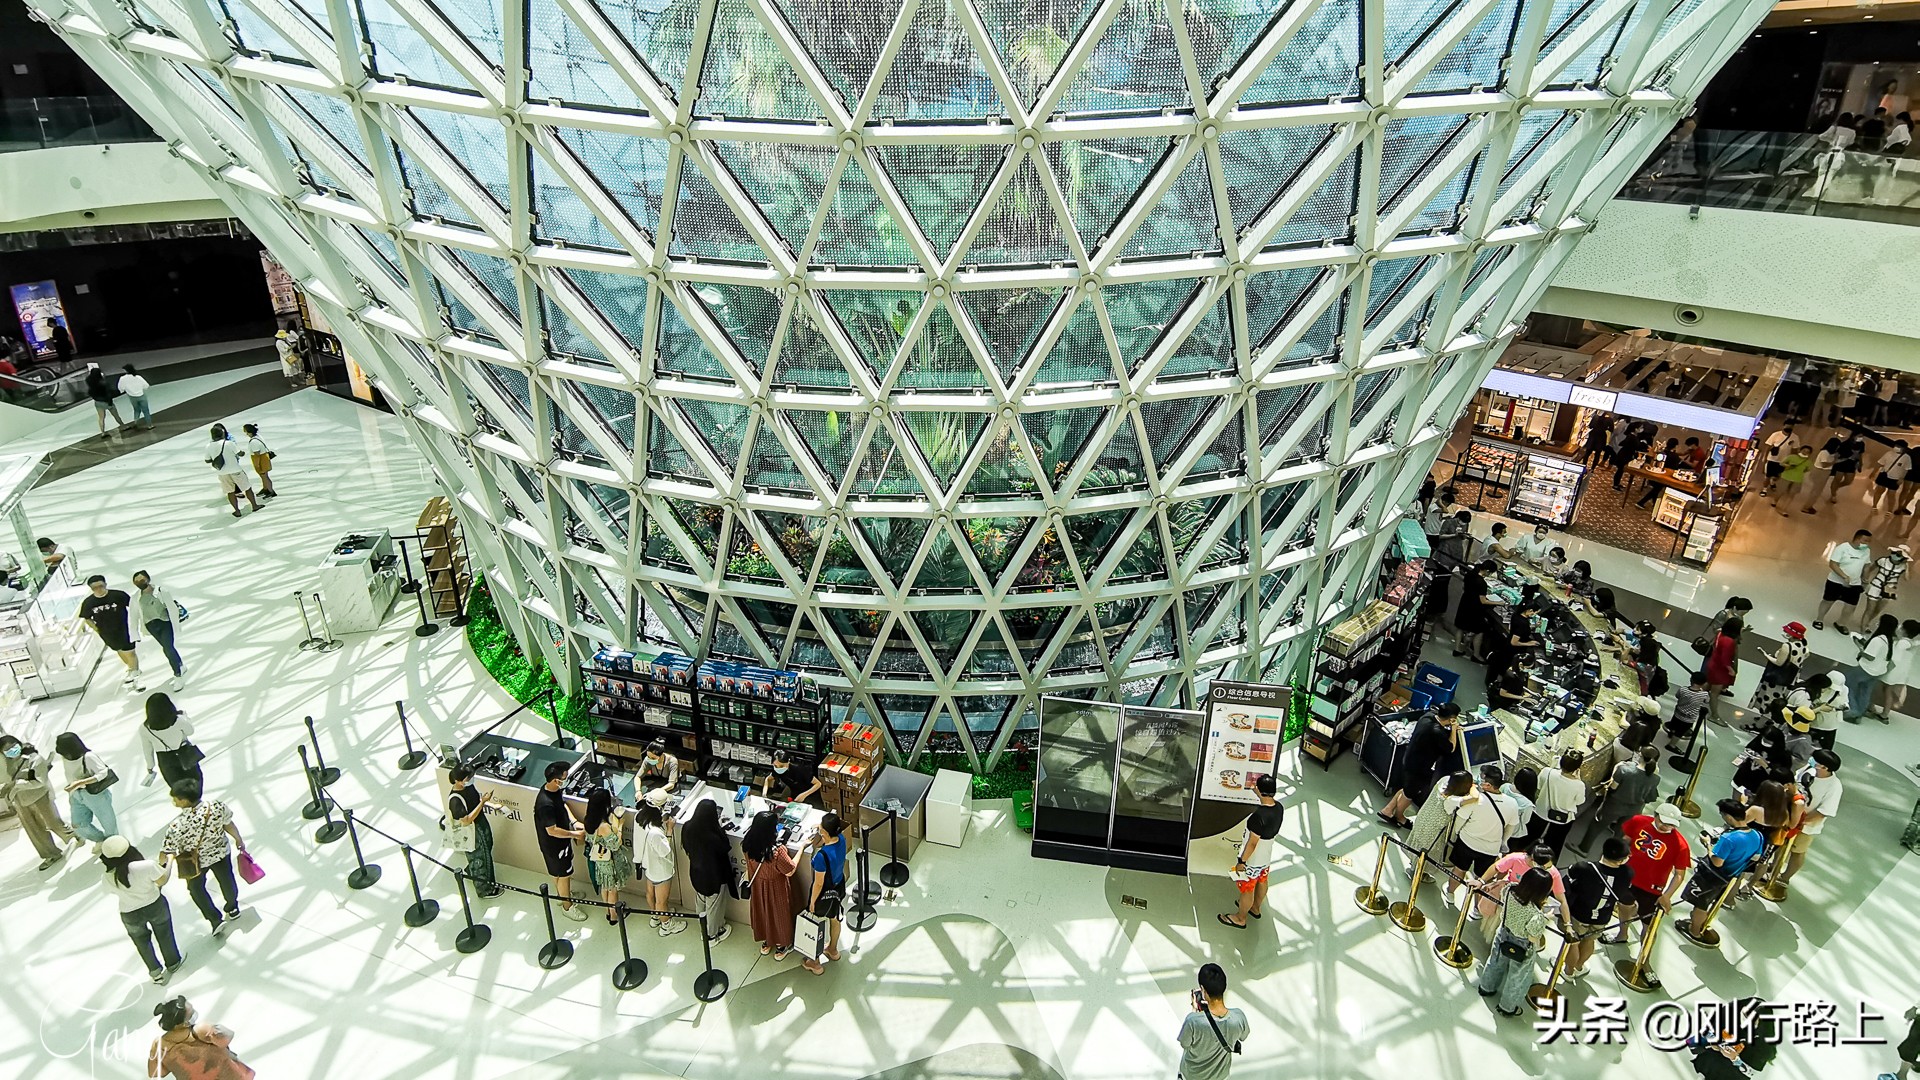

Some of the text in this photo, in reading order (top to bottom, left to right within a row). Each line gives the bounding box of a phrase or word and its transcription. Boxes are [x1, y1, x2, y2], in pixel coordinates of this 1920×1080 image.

[1228, 688, 1276, 699] 综合信息导视
[1634, 829, 1668, 861] 23
